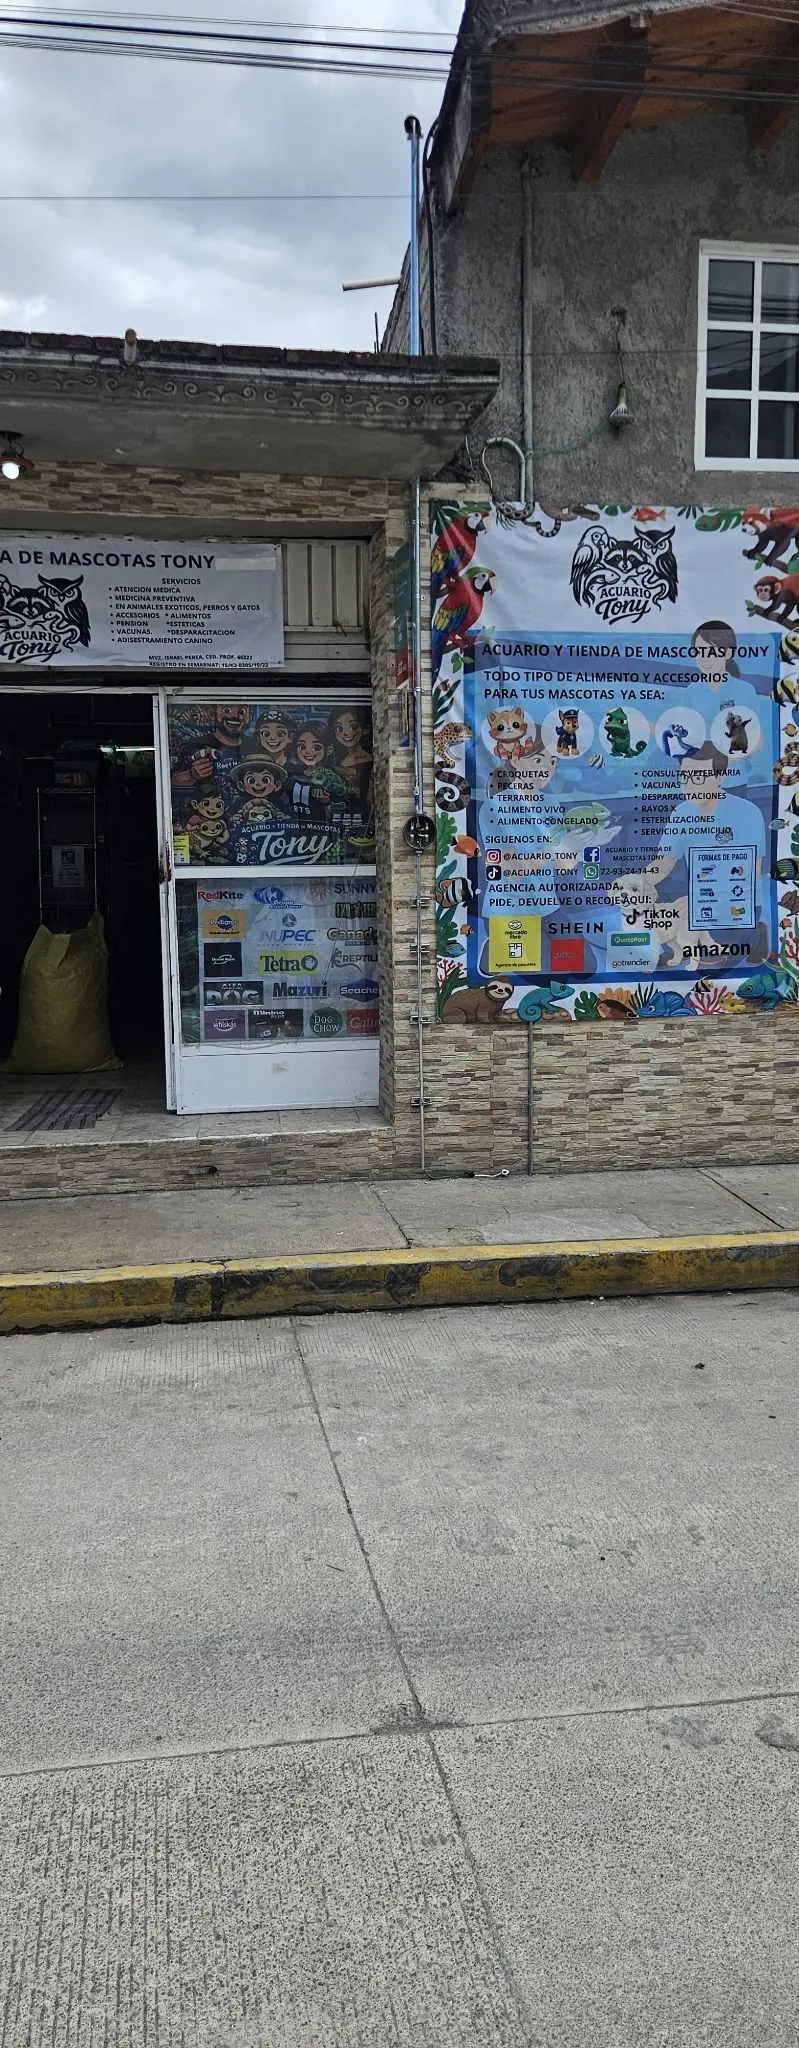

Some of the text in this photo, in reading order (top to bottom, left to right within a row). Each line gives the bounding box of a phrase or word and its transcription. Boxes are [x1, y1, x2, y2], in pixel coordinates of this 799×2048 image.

[19, 551, 43, 565] DE
[50, 552, 156, 568] MASCOTAS
[161, 554, 215, 569] TONY
[599, 587, 651, 599] ACUARIO
[165, 604, 202, 612] EXOTICOS,
[595, 598, 651, 625] Tony
[4, 631, 61, 643] ACUARIO
[0, 640, 62, 663] Tony
[482, 643, 769, 658] ACUARIO Y TIENDA DE MASCOTAS TONY
[484, 671, 728, 683] TODO TIPO DE ALIMENTO Y ACCESORIOS
[484, 688, 665, 700] PARA TUS MASCOTAS YA SEA:
[497, 770, 549, 779] CROQUETAS
[641, 769, 741, 778] CONSULTA VETERINARIA
[497, 782, 534, 790] PECERAS
[641, 781, 681, 789] VACUNAS
[497, 794, 545, 802] TERRARIOS
[641, 792, 727, 801] DESPARACITACIONES
[293, 805, 311, 815] BTS
[497, 806, 542, 814] ALIMENTO
[544, 817, 599, 825] CONGELADO
[641, 815, 716, 824] ESTERILIZACIONES
[241, 824, 271, 833] ACUARIO
[307, 823, 341, 834] MASCOTAS
[641, 826, 732, 836] SERVICIO A DOMICILIO
[485, 835, 552, 844] SIGUENOS EN:
[252, 830, 333, 865] Tony
[503, 852, 578, 861] @ACUARIO_TONY
[698, 853, 748, 862] FORMAS DE PAGO
[503, 868, 579, 878] @ACUARIO_TONY
[600, 866, 660, 876] 72-93-24-14-43
[334, 883, 377, 894] SUNNY
[488, 883, 536, 893] AGENCIA
[197, 891, 244, 903] RedKite
[489, 895, 652, 908] PIDE, DEVUELVE O RECOJE AQUI:
[643, 909, 680, 919] TikTok
[548, 921, 604, 934] SHEIN
[643, 919, 673, 930] Shop
[260, 929, 317, 942] NUPEC
[682, 943, 751, 958] amazon
[260, 955, 301, 972] Tetra
[611, 959, 651, 968] gotrendier
[273, 980, 328, 998] Mazuri
[212, 1020, 237, 1028] whiskas
[314, 1015, 333, 1024] DOG
[313, 1024, 340, 1033] CHOW
